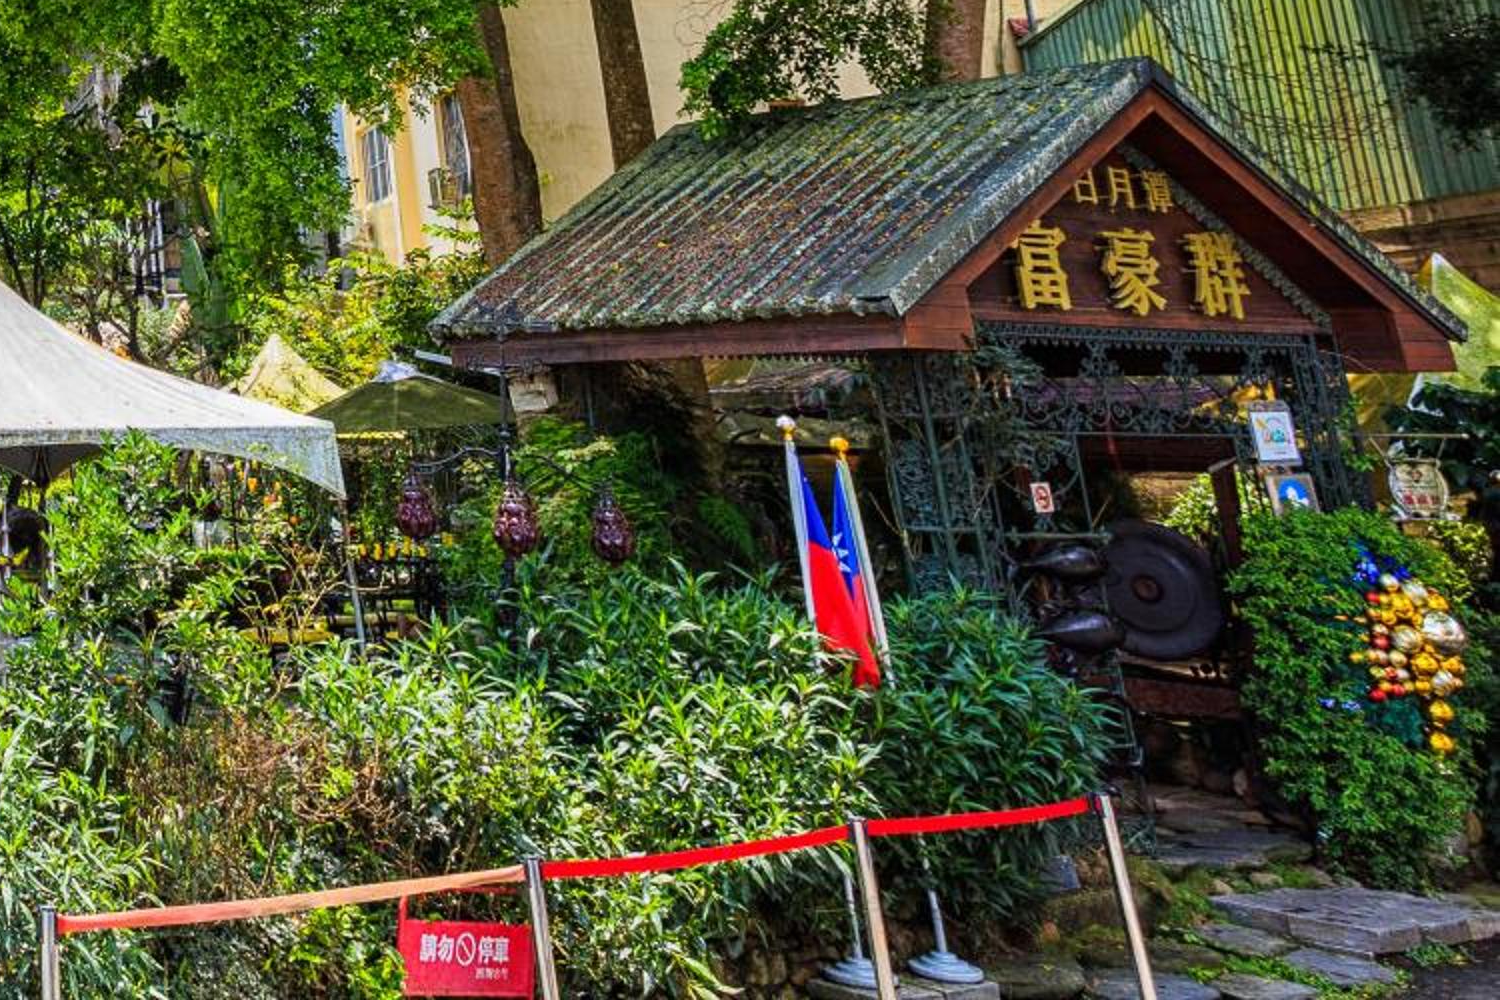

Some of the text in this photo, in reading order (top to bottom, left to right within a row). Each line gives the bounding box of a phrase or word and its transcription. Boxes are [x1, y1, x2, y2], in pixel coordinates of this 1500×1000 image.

[1074, 166, 1174, 213] 日月潭
[1014, 219, 1251, 320] 富豪群
[420, 933, 510, 964] 請勿 停車
